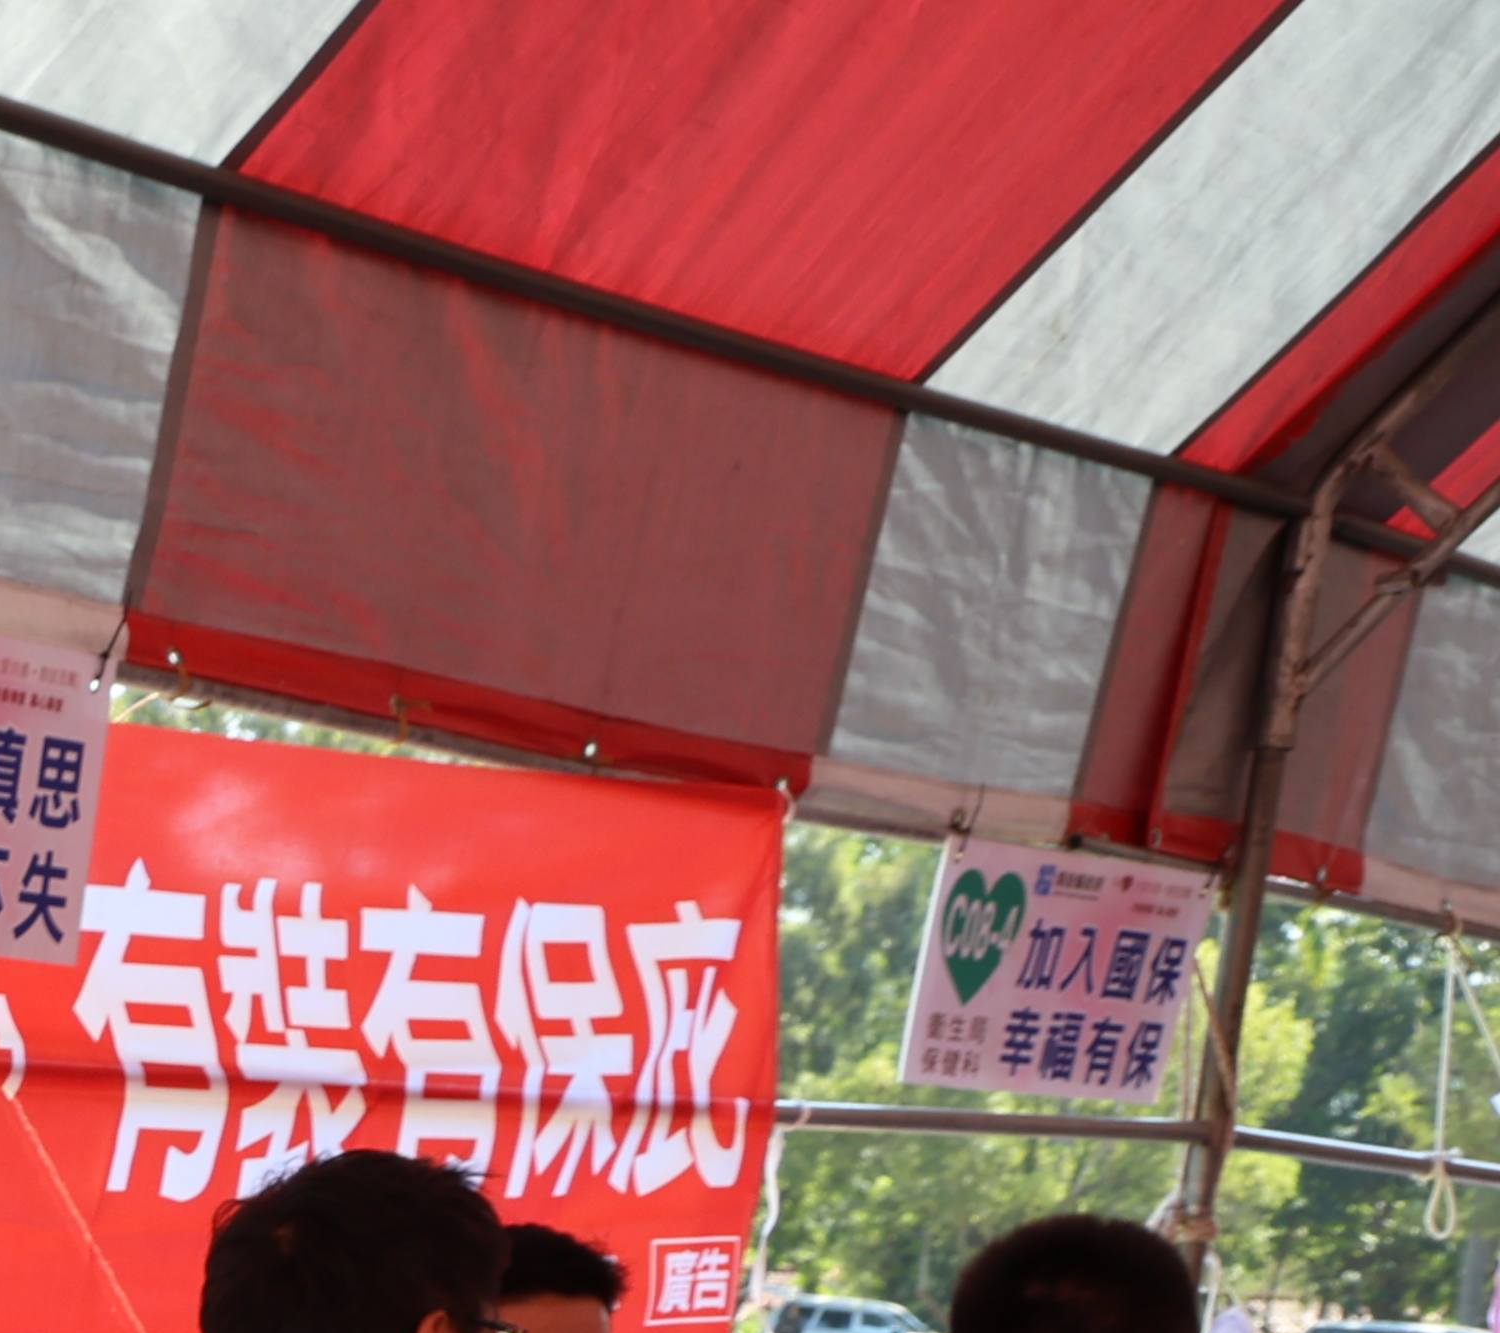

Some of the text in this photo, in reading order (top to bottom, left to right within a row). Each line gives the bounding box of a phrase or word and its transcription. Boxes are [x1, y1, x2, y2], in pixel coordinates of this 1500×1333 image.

[1015, 918, 1188, 1005] 加入國保
[1000, 1007, 1164, 1089] 幸福有保
[657, 1247, 731, 1316] 廣告
